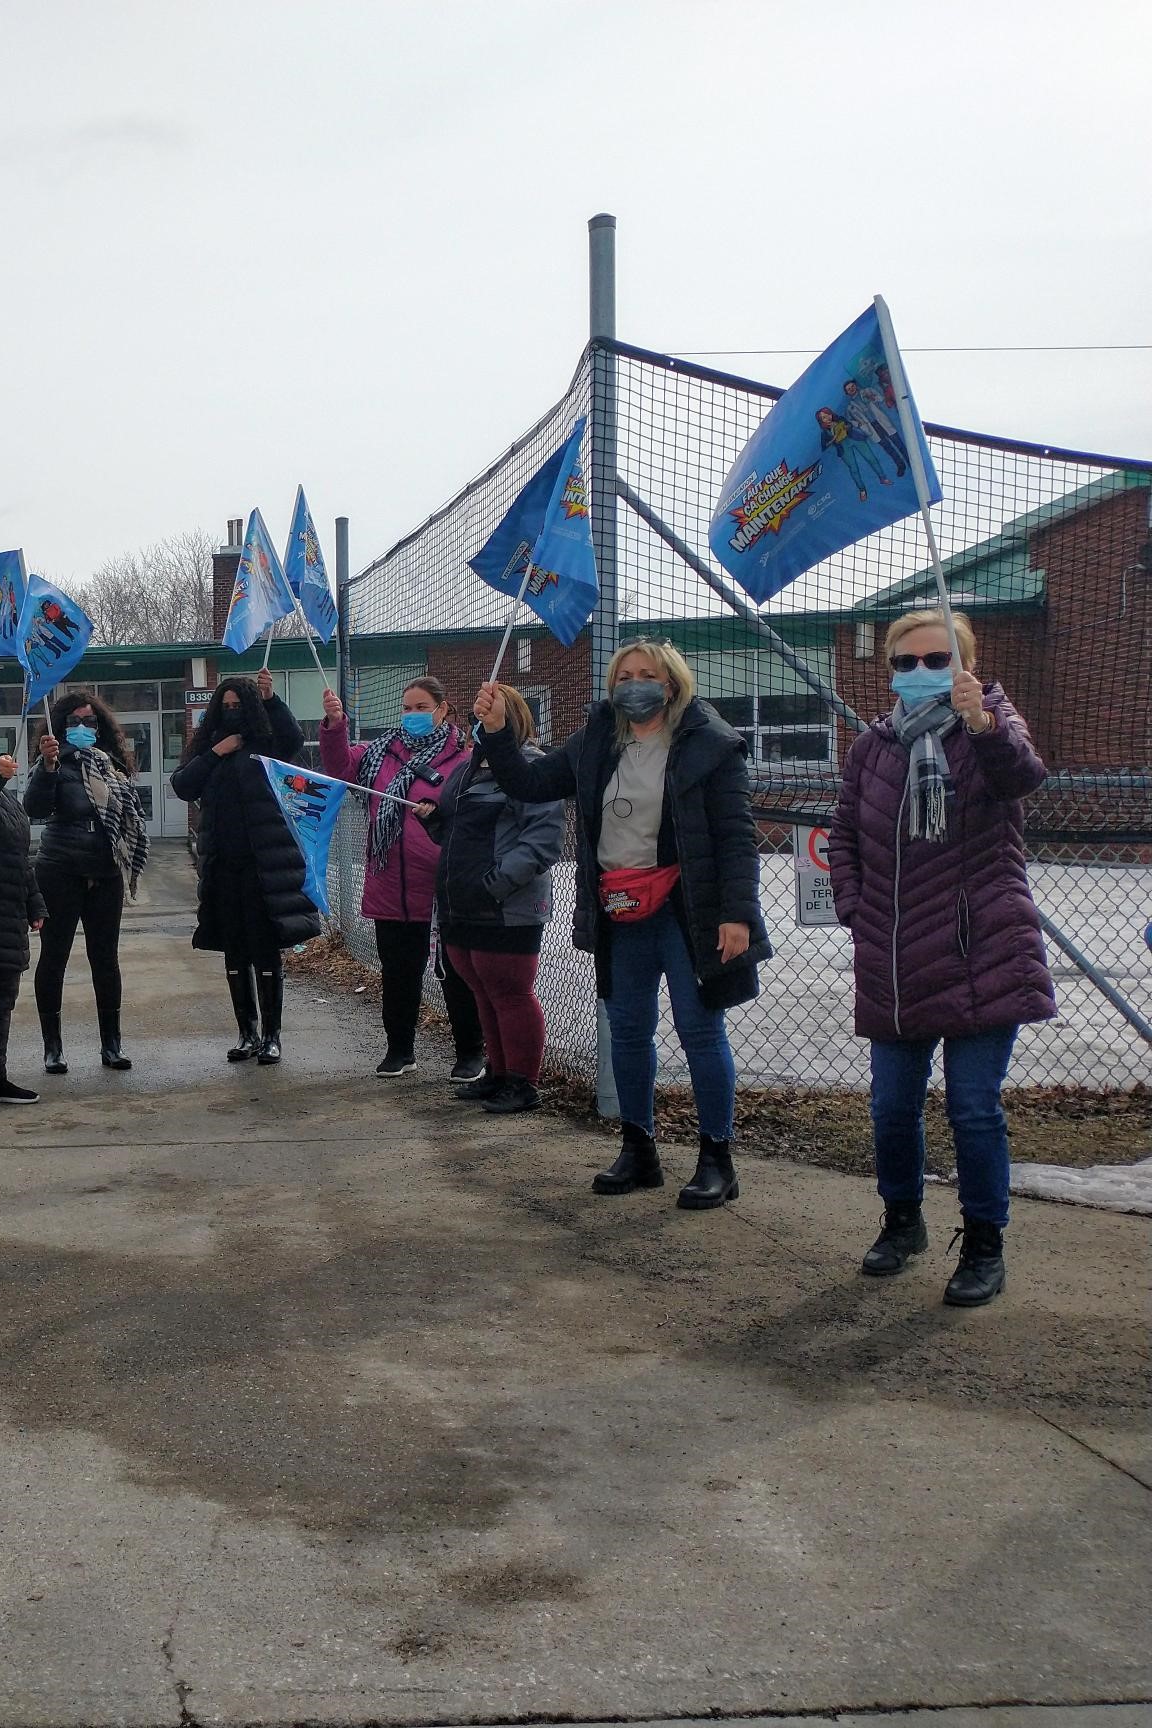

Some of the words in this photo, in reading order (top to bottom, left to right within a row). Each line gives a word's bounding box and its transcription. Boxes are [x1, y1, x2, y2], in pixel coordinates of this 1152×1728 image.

[742, 480, 765, 504] FAUT
[765, 465, 785, 486] QUE
[757, 471, 795, 505] CHANGE
[189, 693, 213, 702] 8330
[806, 901, 821, 910] DE
